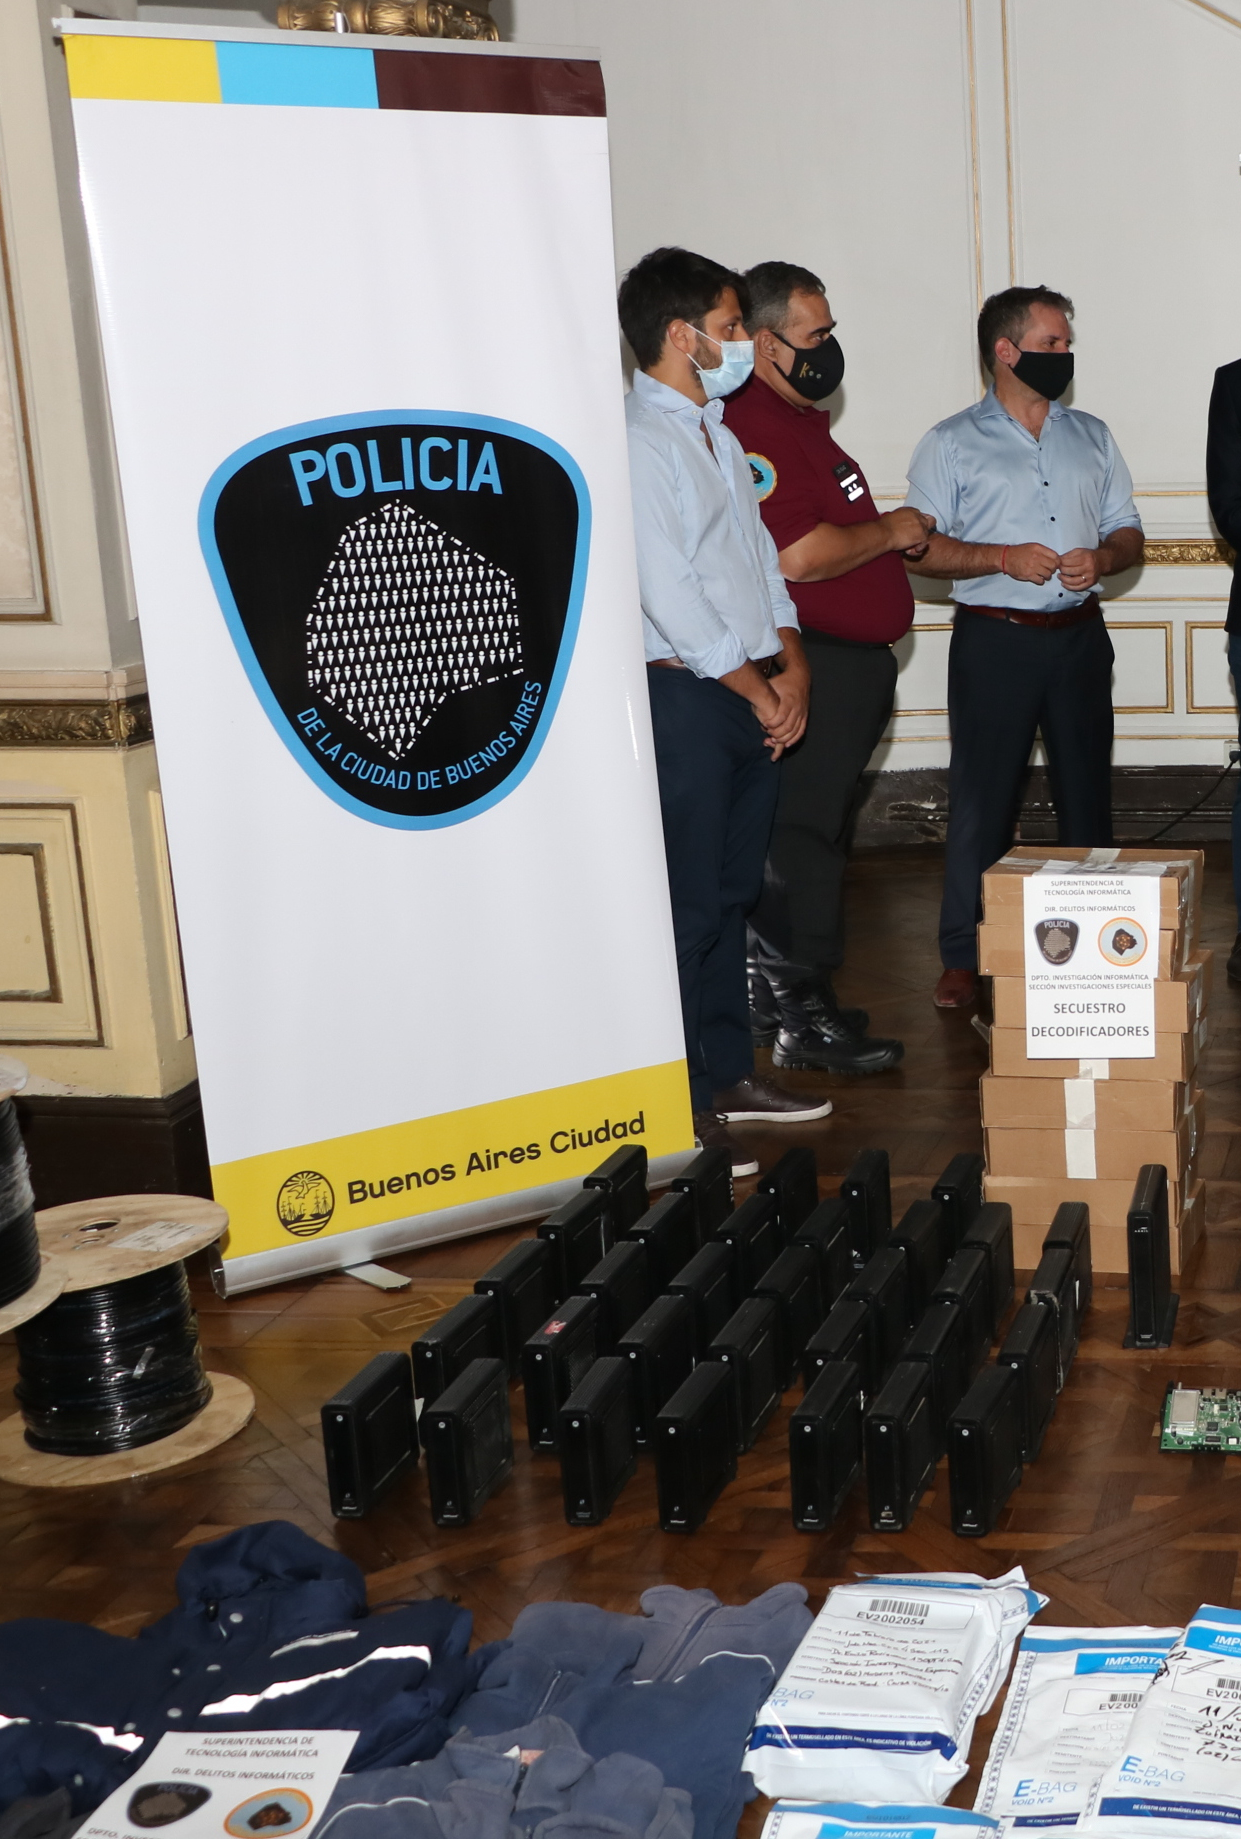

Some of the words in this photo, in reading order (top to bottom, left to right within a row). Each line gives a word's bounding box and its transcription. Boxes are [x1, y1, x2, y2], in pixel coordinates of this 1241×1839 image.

[289, 437, 503, 506] POLICIA
[297, 707, 325, 737] DE
[315, 732, 341, 763] LA
[341, 752, 411, 790] CIUDAD
[417, 770, 442, 790] DE
[447, 732, 516, 785] BUENOS
[513, 680, 543, 738] AIRES
[1044, 888, 1085, 896] TECNOLOGÍA
[1086, 887, 1131, 895] INFORMÁTICA
[1086, 904, 1136, 912] INFORMÁTICOS
[1043, 920, 1070, 929] POLICIA
[1052, 973, 1102, 981] INVESTIGACIÓN
[1103, 973, 1149, 981] INFORMÁTICA
[1028, 982, 1056, 990] SECCIÓN
[1053, 1003, 1126, 1014] SECUESTRO
[1031, 1026, 1150, 1037] DECODIFICADORES
[347, 1163, 456, 1204] Buenos
[466, 1141, 542, 1177] Aires
[550, 1110, 646, 1154] Ciudad
[856, 1611, 925, 1626] EV2002054
[202, 1737, 299, 1746] SUPERINTENDENCIA
[300, 1737, 314, 1745] DE
[185, 1748, 248, 1758] TECNOLOGÍA
[250, 1748, 319, 1757] INFORMÁTICA
[194, 1768, 235, 1778] DELITOS
[238, 1770, 315, 1780] INFORMÁTICOS
[1120, 1755, 1186, 1782] E-BAG
[1118, 1774, 1142, 1784] VOID
[1012, 1778, 1078, 1799] E-BAG
[1011, 1796, 1035, 1807] VOID
